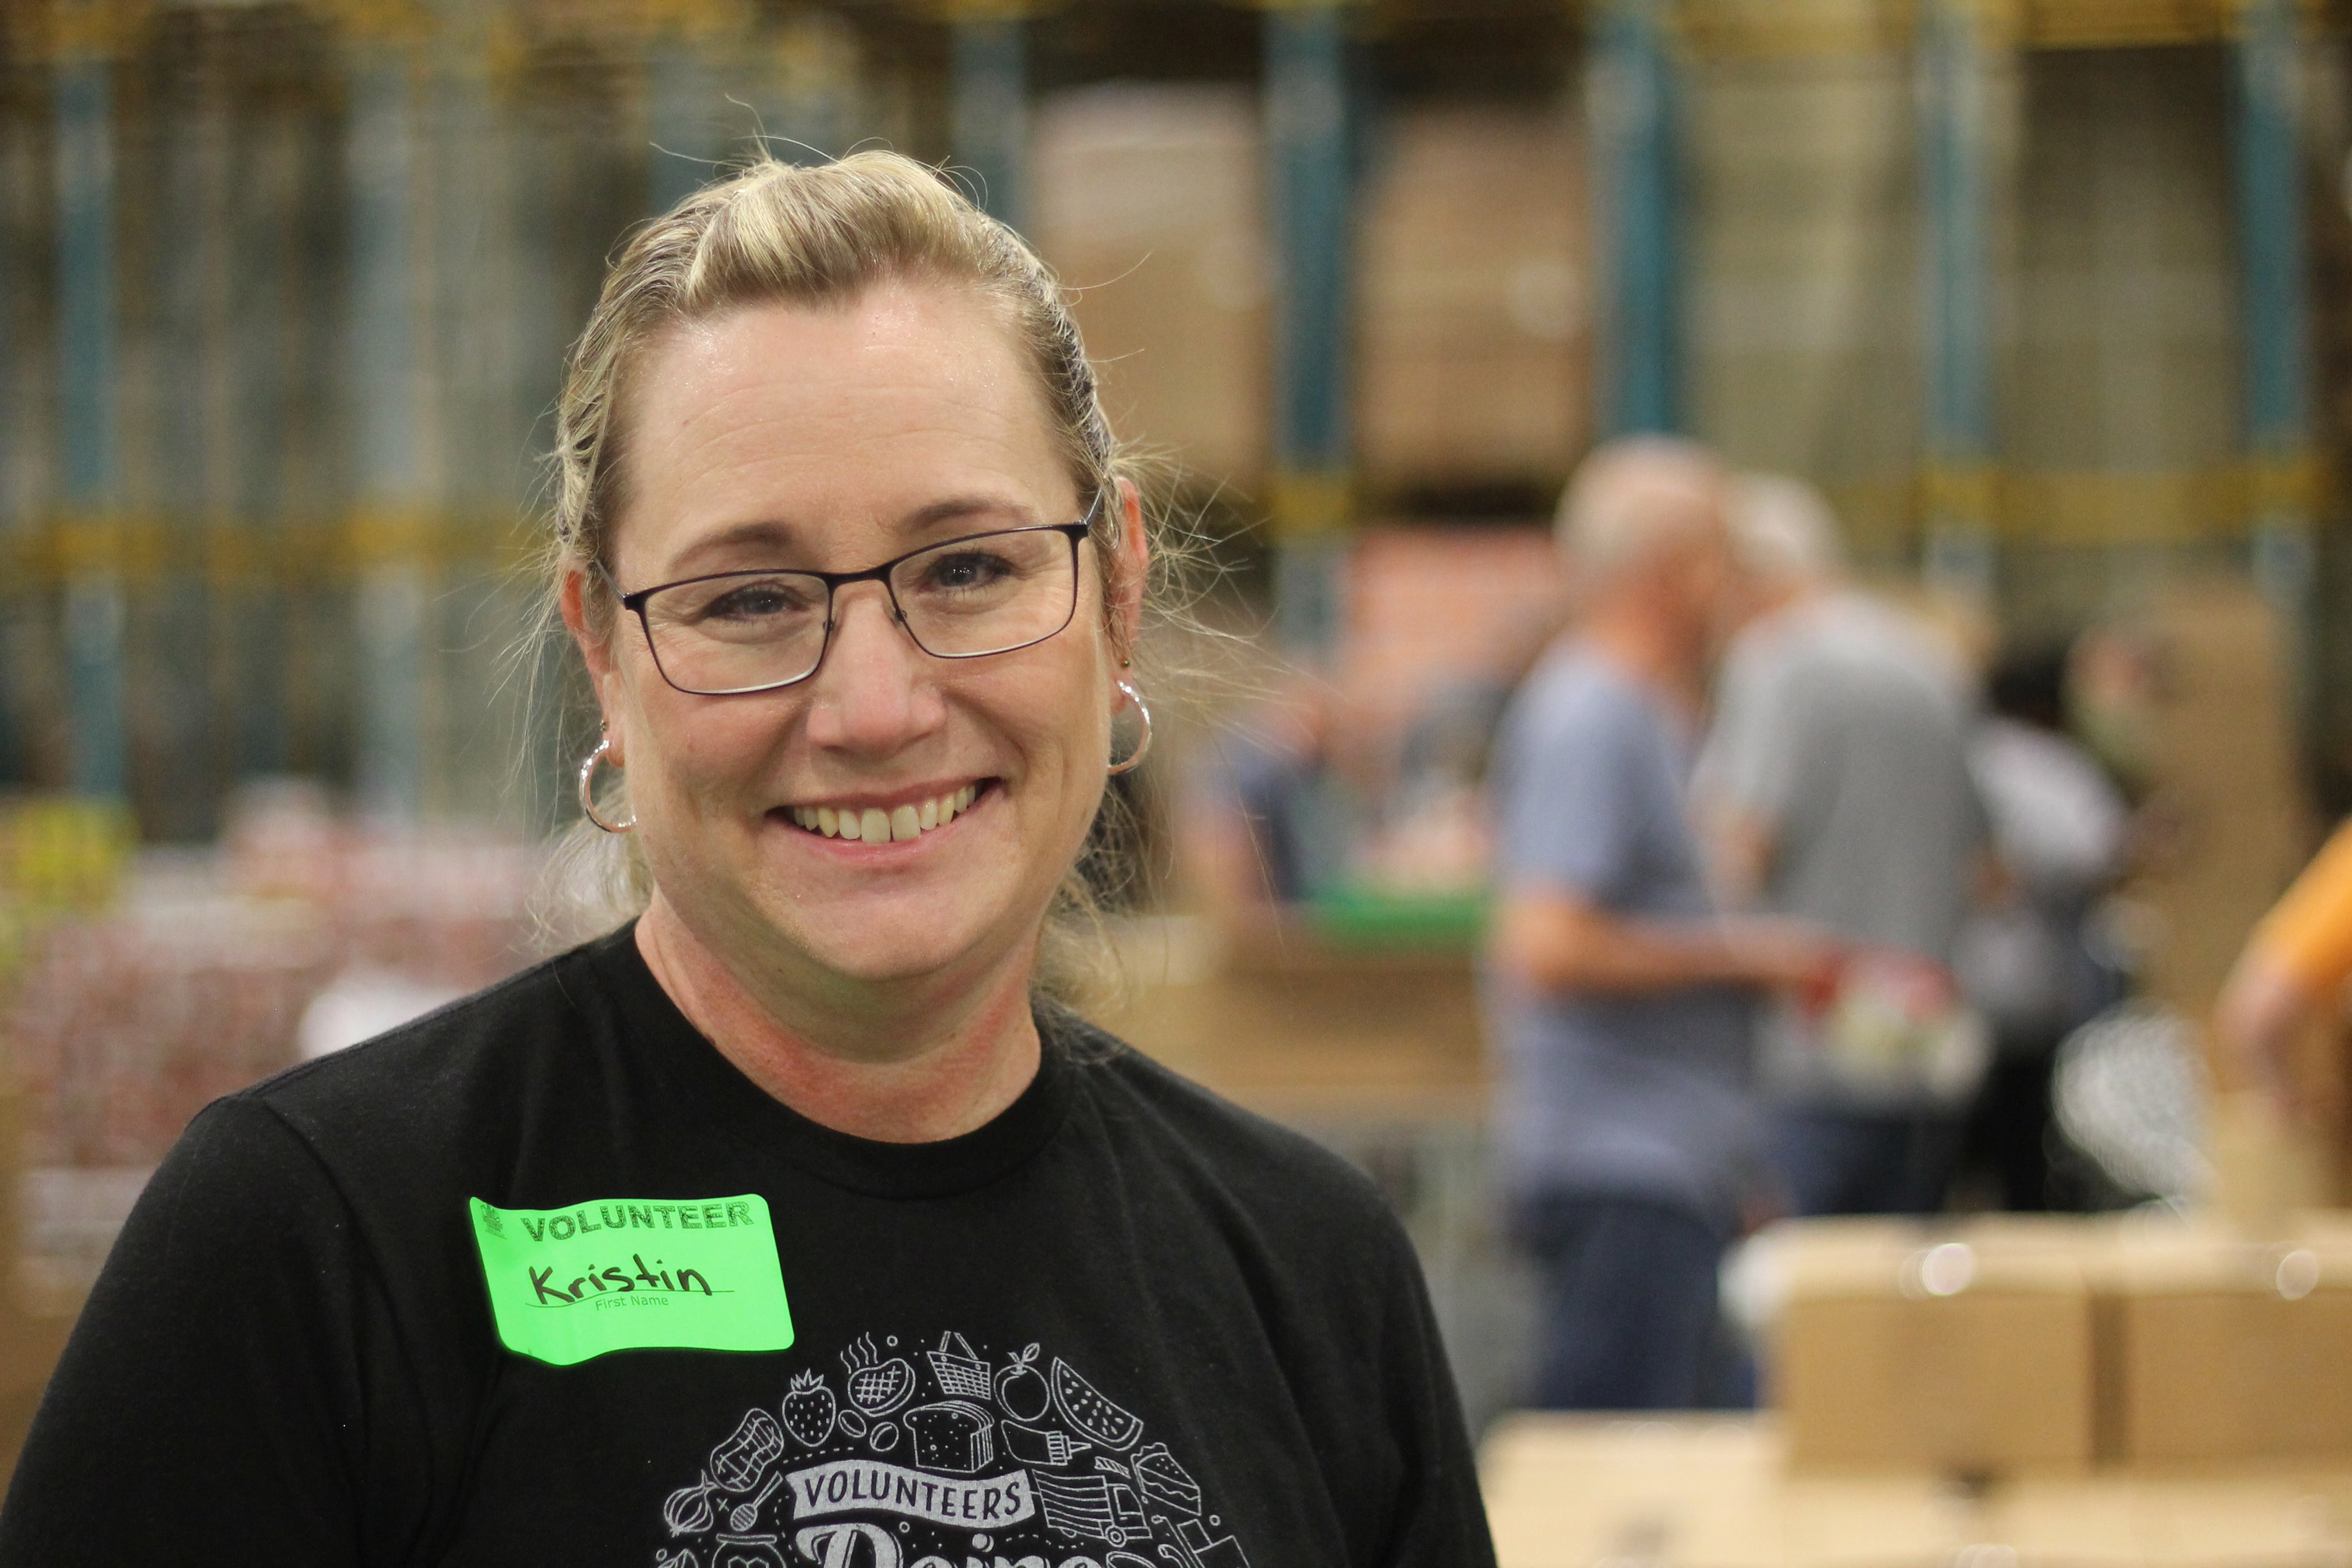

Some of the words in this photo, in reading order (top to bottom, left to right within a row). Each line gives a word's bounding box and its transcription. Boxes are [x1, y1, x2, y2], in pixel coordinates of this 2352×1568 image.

[520, 1201, 755, 1242] VOLUNTEER
[528, 1253, 713, 1304] Kristin
[595, 1295, 626, 1311] First
[632, 1295, 669, 1306] Name
[804, 1469, 1021, 1520] VOLUNTEERS
